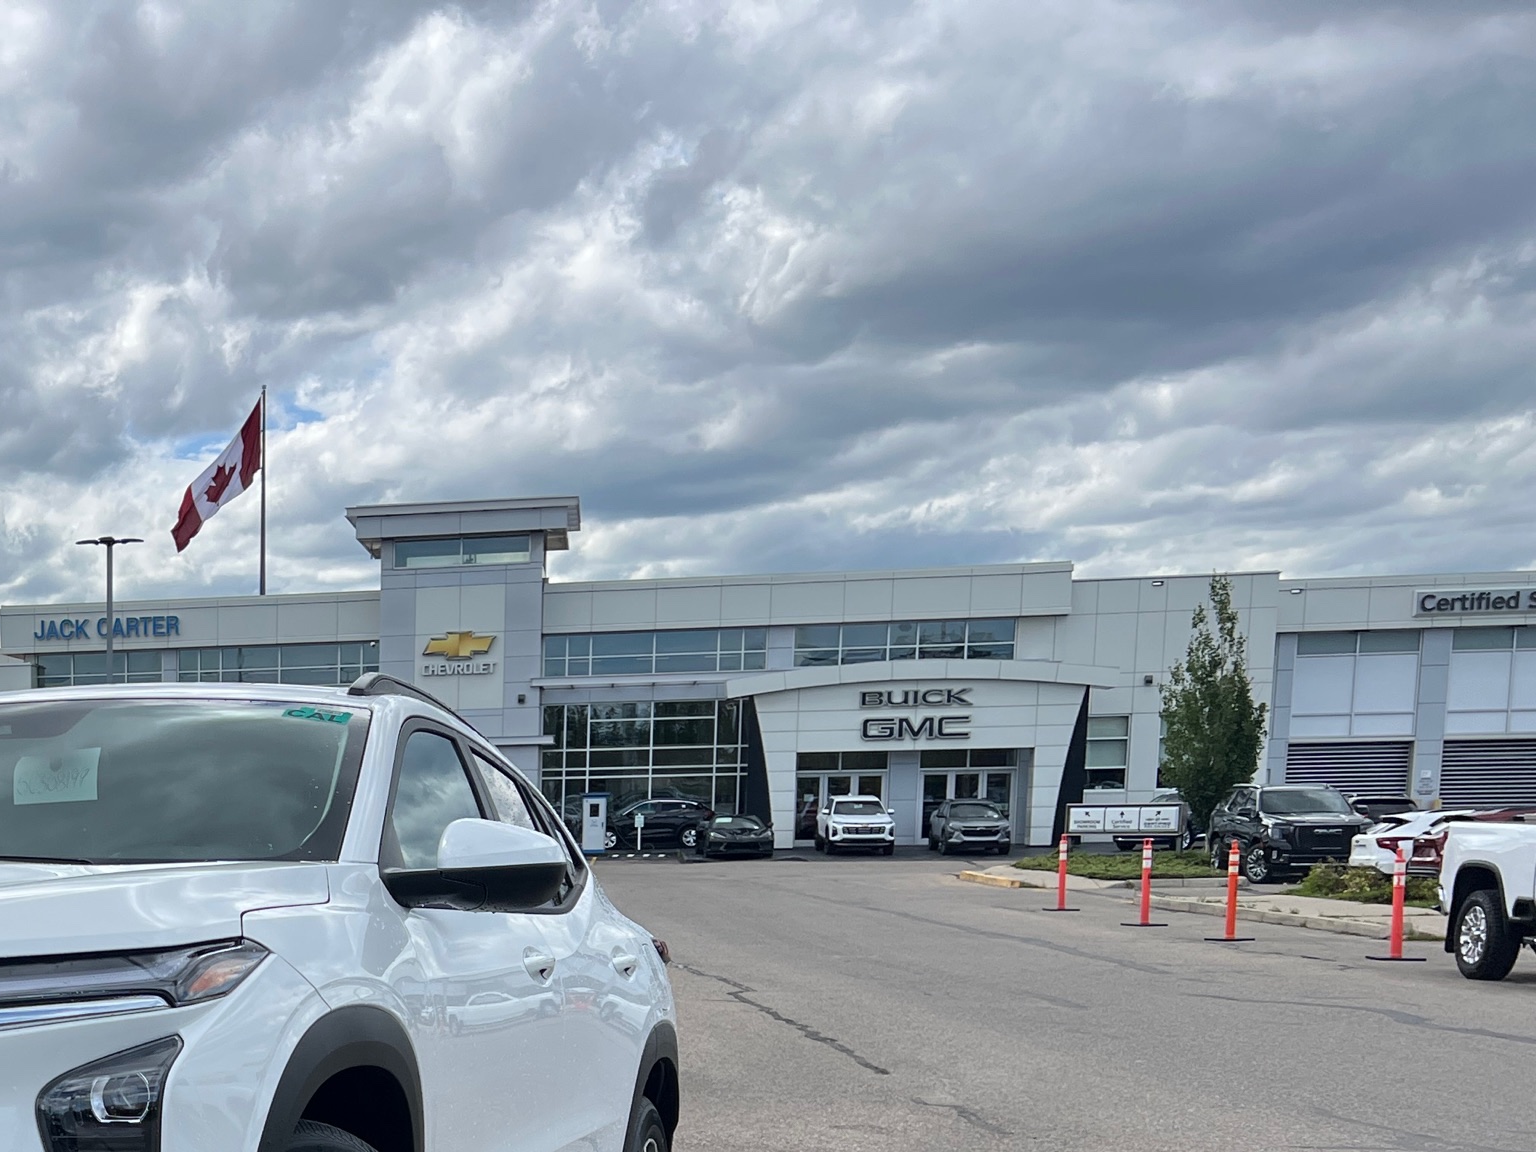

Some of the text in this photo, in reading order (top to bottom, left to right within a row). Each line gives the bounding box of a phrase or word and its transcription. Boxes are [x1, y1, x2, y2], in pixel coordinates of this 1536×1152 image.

[1420, 591, 1521, 612] Certified
[33, 615, 181, 641] JACK CARTER
[421, 662, 497, 677] CHEVROLET
[859, 687, 974, 709] BUICK
[287, 709, 343, 724] CAL
[860, 714, 972, 742] GMC
